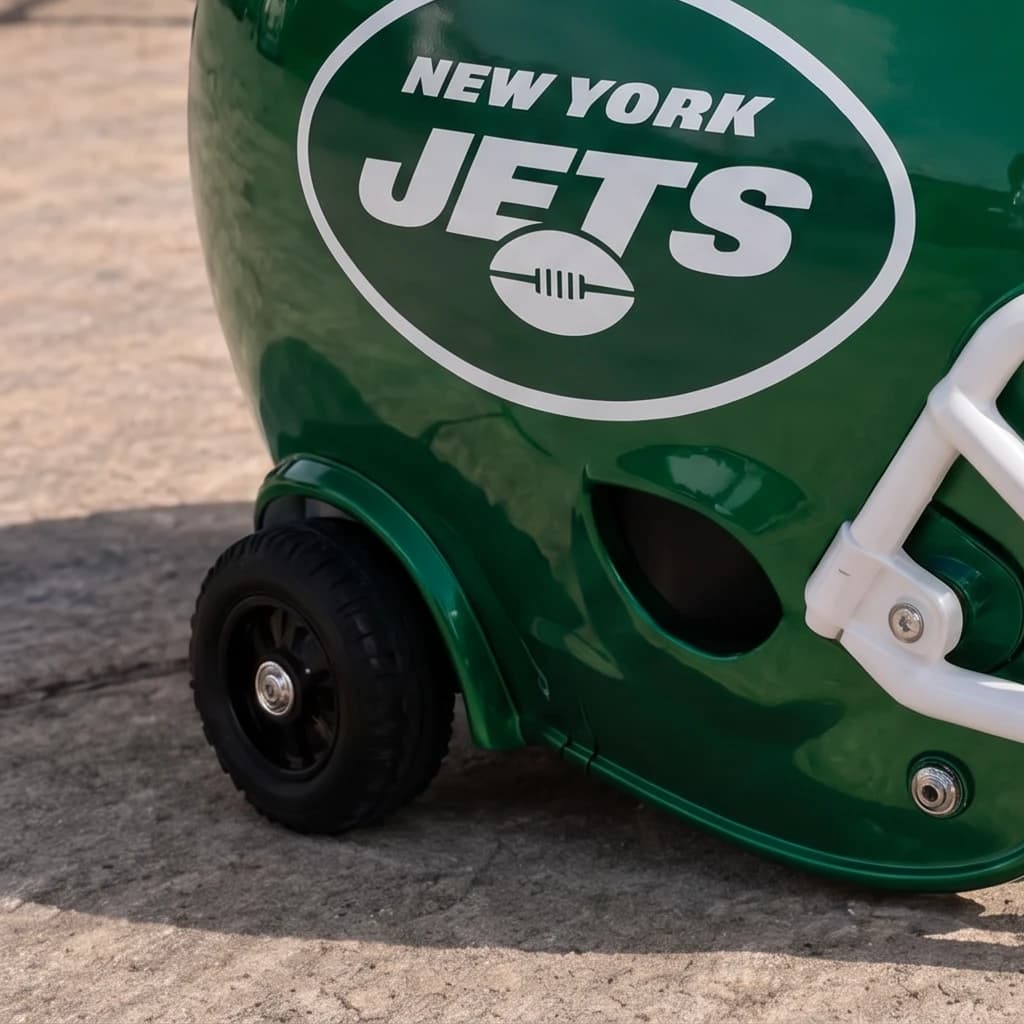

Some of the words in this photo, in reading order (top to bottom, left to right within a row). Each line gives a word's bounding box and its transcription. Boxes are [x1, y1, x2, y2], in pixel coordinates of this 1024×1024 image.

[401, 55, 558, 111] NEW
[566, 76, 775, 138] YORK
[358, 127, 814, 278] JETS
